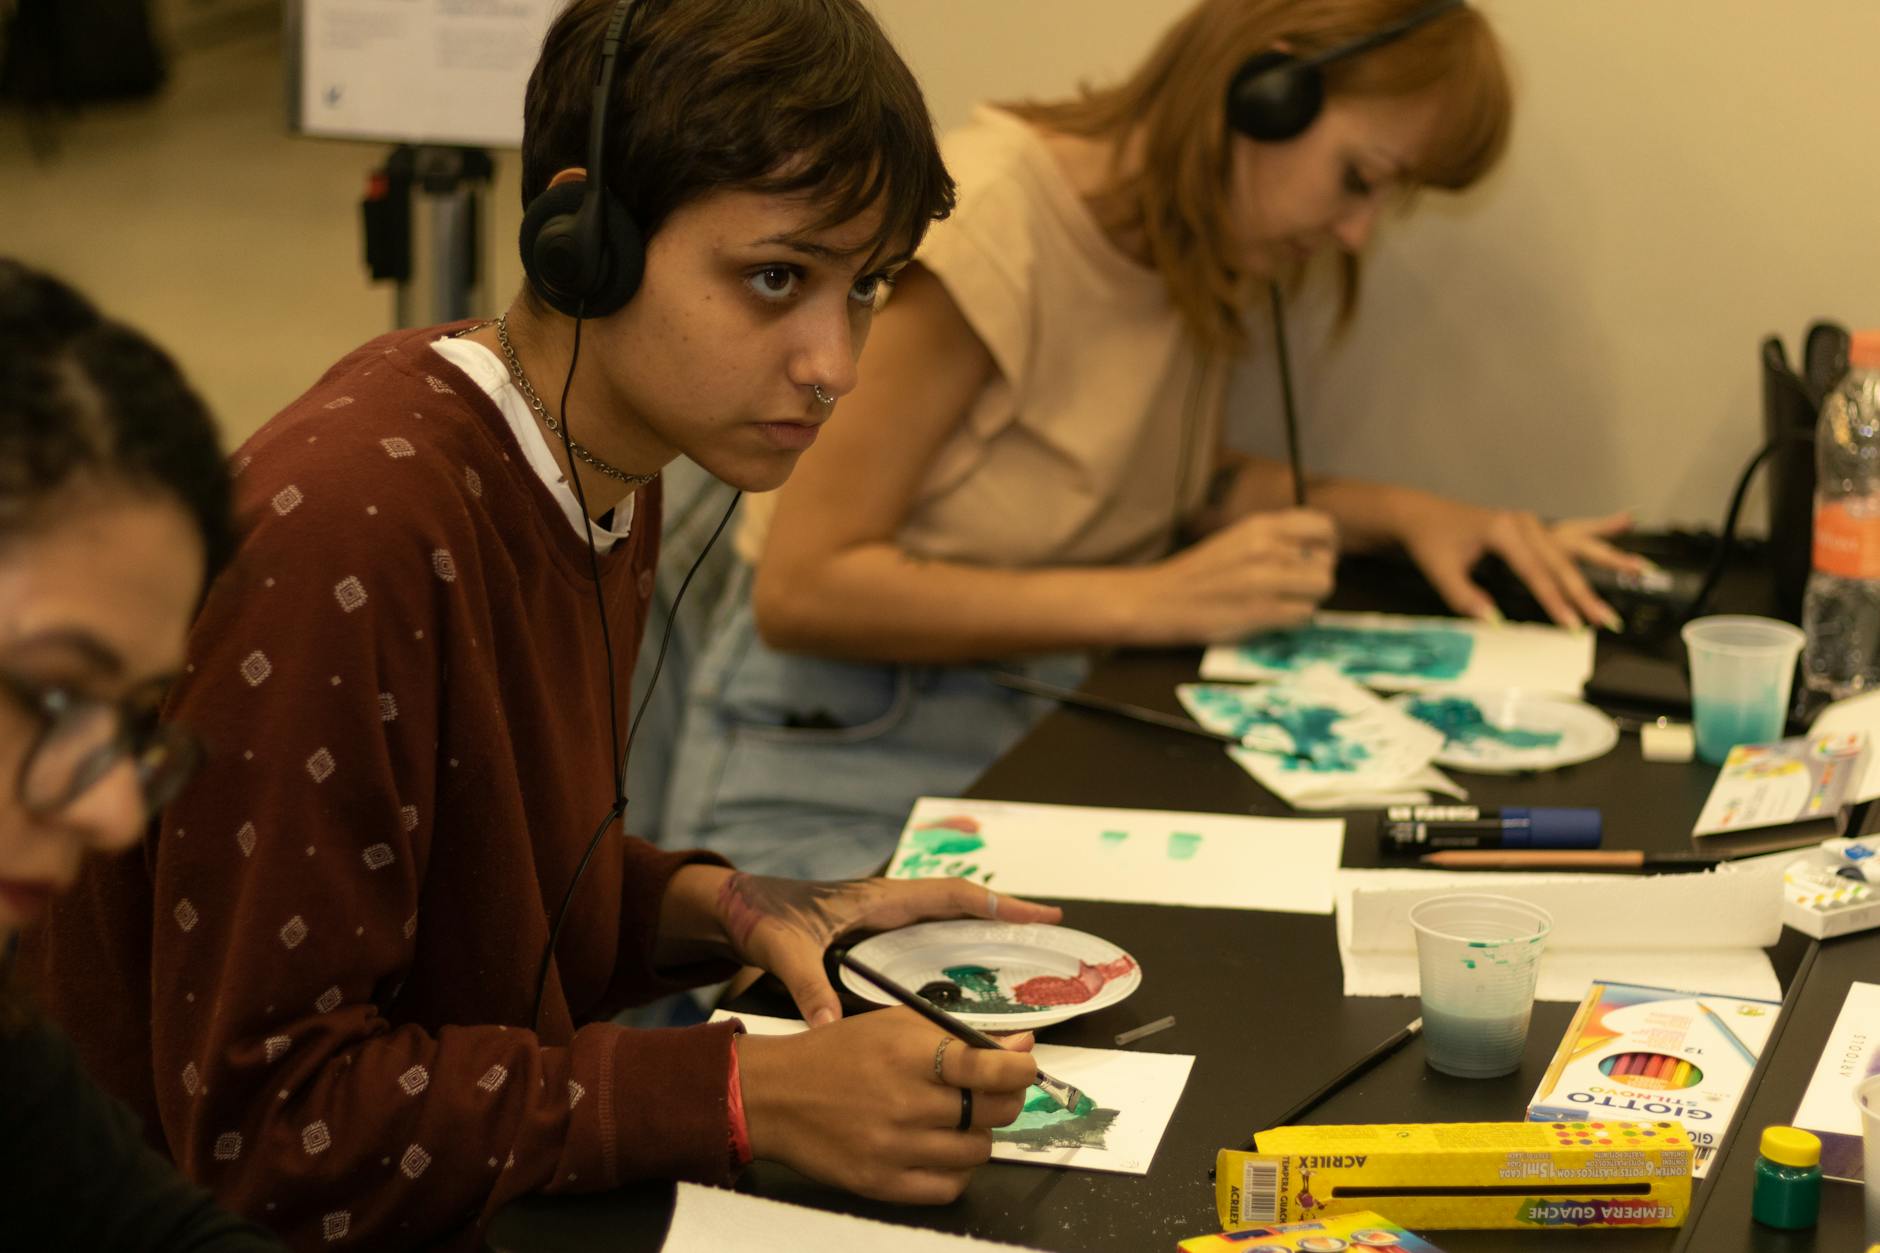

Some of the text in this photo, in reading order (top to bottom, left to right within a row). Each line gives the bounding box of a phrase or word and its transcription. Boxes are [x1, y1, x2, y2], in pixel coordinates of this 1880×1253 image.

[1683, 1046, 1705, 1056] 12
[1838, 1033, 1867, 1078] ARTOOLS
[1588, 1086, 1698, 1107] STILNOVO
[1566, 1091, 1713, 1120] GIOTTO
[1686, 1130, 1714, 1145] GIO
[1299, 1155, 1368, 1169] ACRILEX
[1645, 1160, 1655, 1176] 6
[1499, 1169, 1521, 1178] CADA
[1522, 1162, 1557, 1178] 15ml
[1557, 1168, 1575, 1178] COM
[1620, 1167, 1644, 1177] POTES
[1279, 1156, 1290, 1225] TEMPERA GUACH
[1230, 1184, 1240, 1225] ACRILEX
[1528, 1206, 1675, 1219] TEMPERA GUACHE
